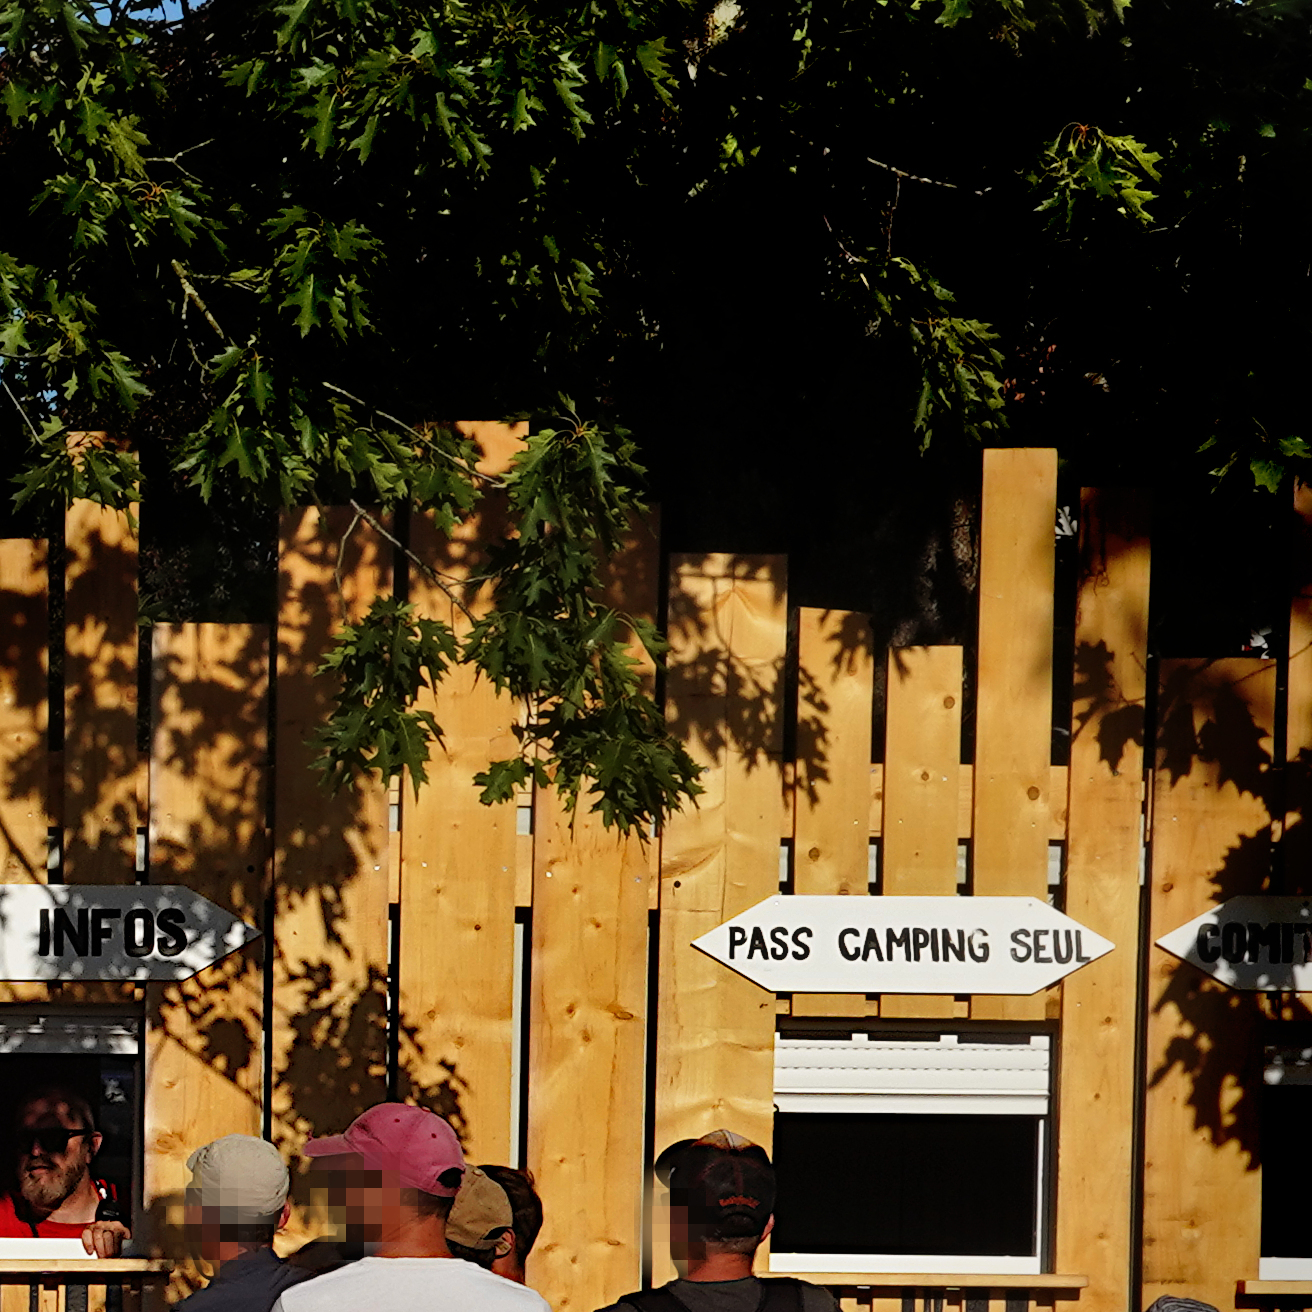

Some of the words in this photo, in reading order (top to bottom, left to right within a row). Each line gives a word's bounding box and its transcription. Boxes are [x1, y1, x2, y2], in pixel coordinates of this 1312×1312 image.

[38, 908, 188, 957] INFOS
[728, 926, 813, 961] PASS
[838, 927, 989, 964] CAMPING
[1010, 928, 1091, 965] SEUL
